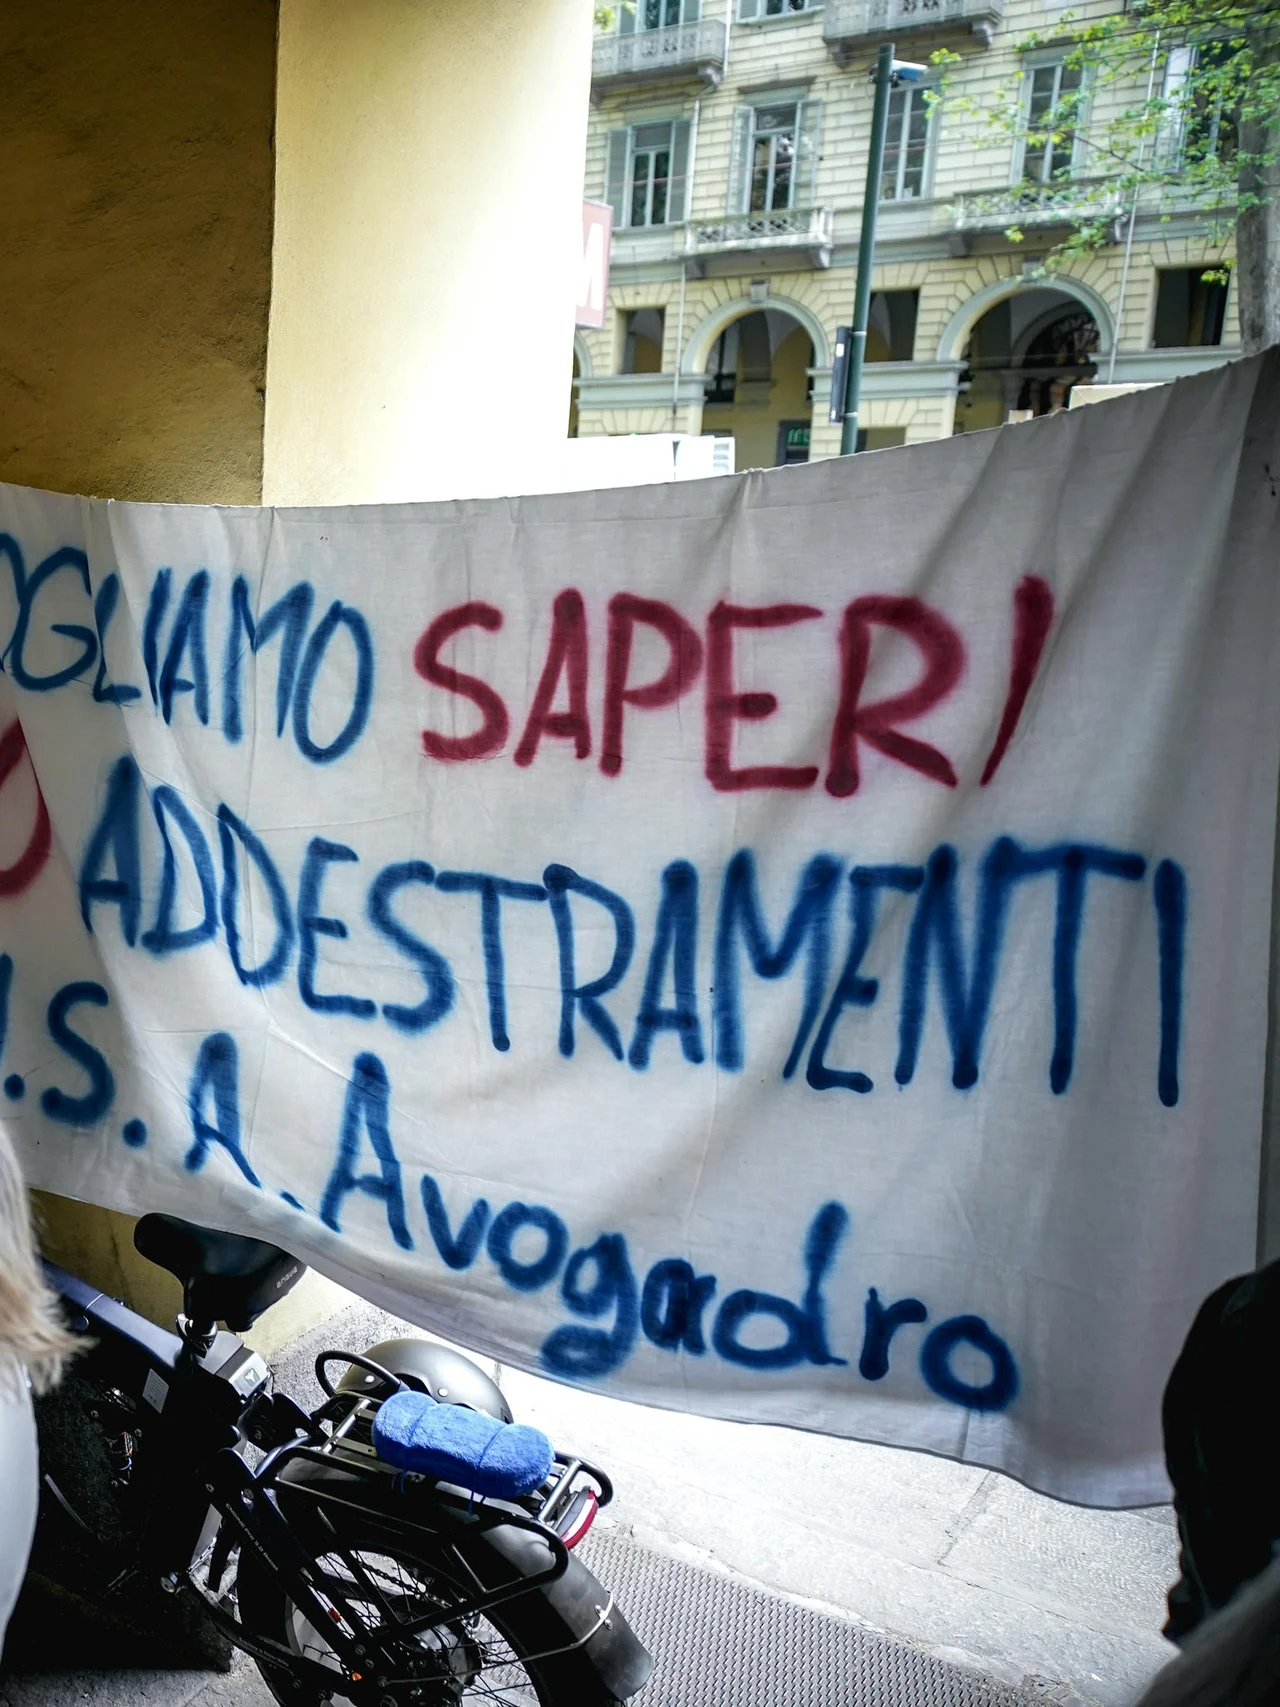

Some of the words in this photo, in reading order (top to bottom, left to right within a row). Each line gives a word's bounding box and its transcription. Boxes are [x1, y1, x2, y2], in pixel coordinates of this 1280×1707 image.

[414, 575, 1054, 798] SAPERI
[79, 752, 1188, 1107] ADDESTRAMENTI
[320, 1051, 1019, 1412] Avogadro
